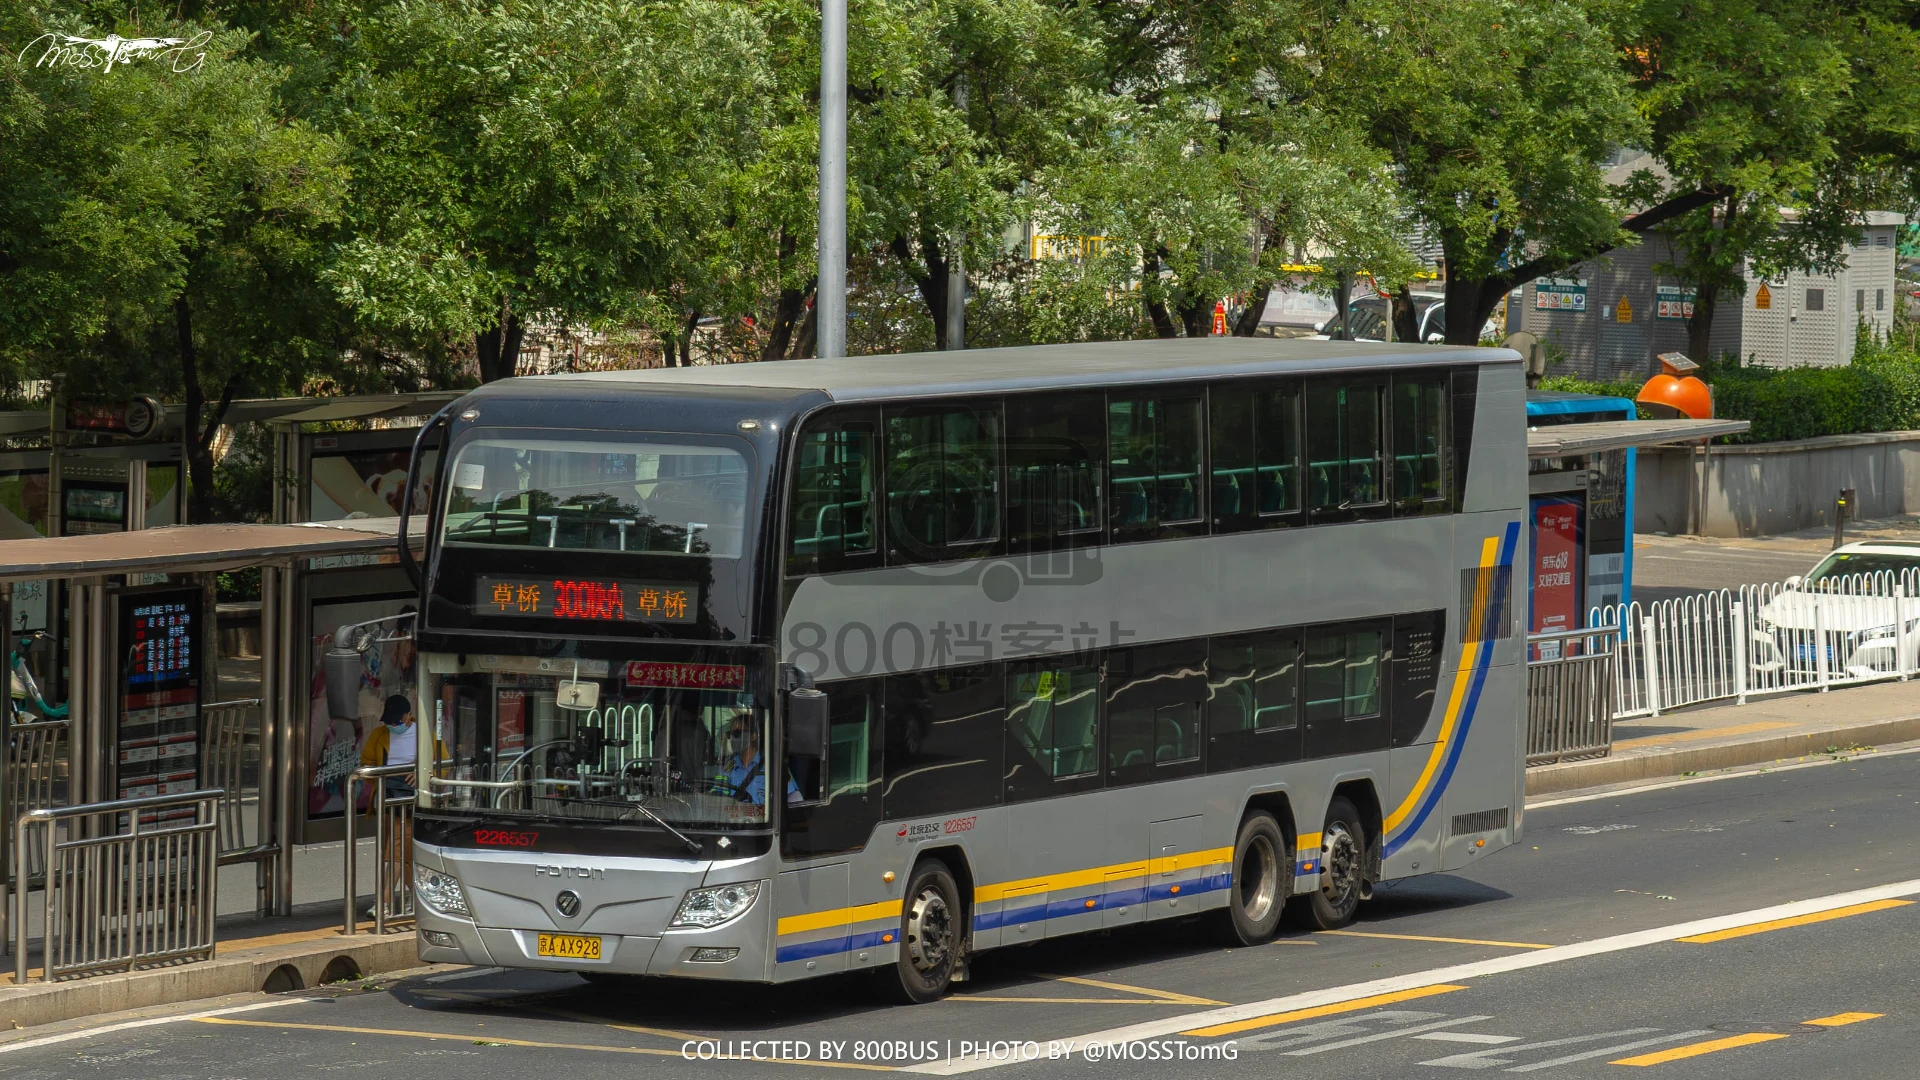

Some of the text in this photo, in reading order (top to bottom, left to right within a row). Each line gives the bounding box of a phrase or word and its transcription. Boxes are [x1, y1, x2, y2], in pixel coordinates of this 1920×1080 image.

[1542, 551, 1569, 569] 京东618
[1538, 572, 1571, 588] 又好又便宜
[490, 583, 541, 613] 草桥
[636, 589, 688, 619] 草桥
[909, 816, 976, 835] 北京公交 1226557
[473, 829, 540, 847] 1226557
[535, 864, 605, 881] FOTON
